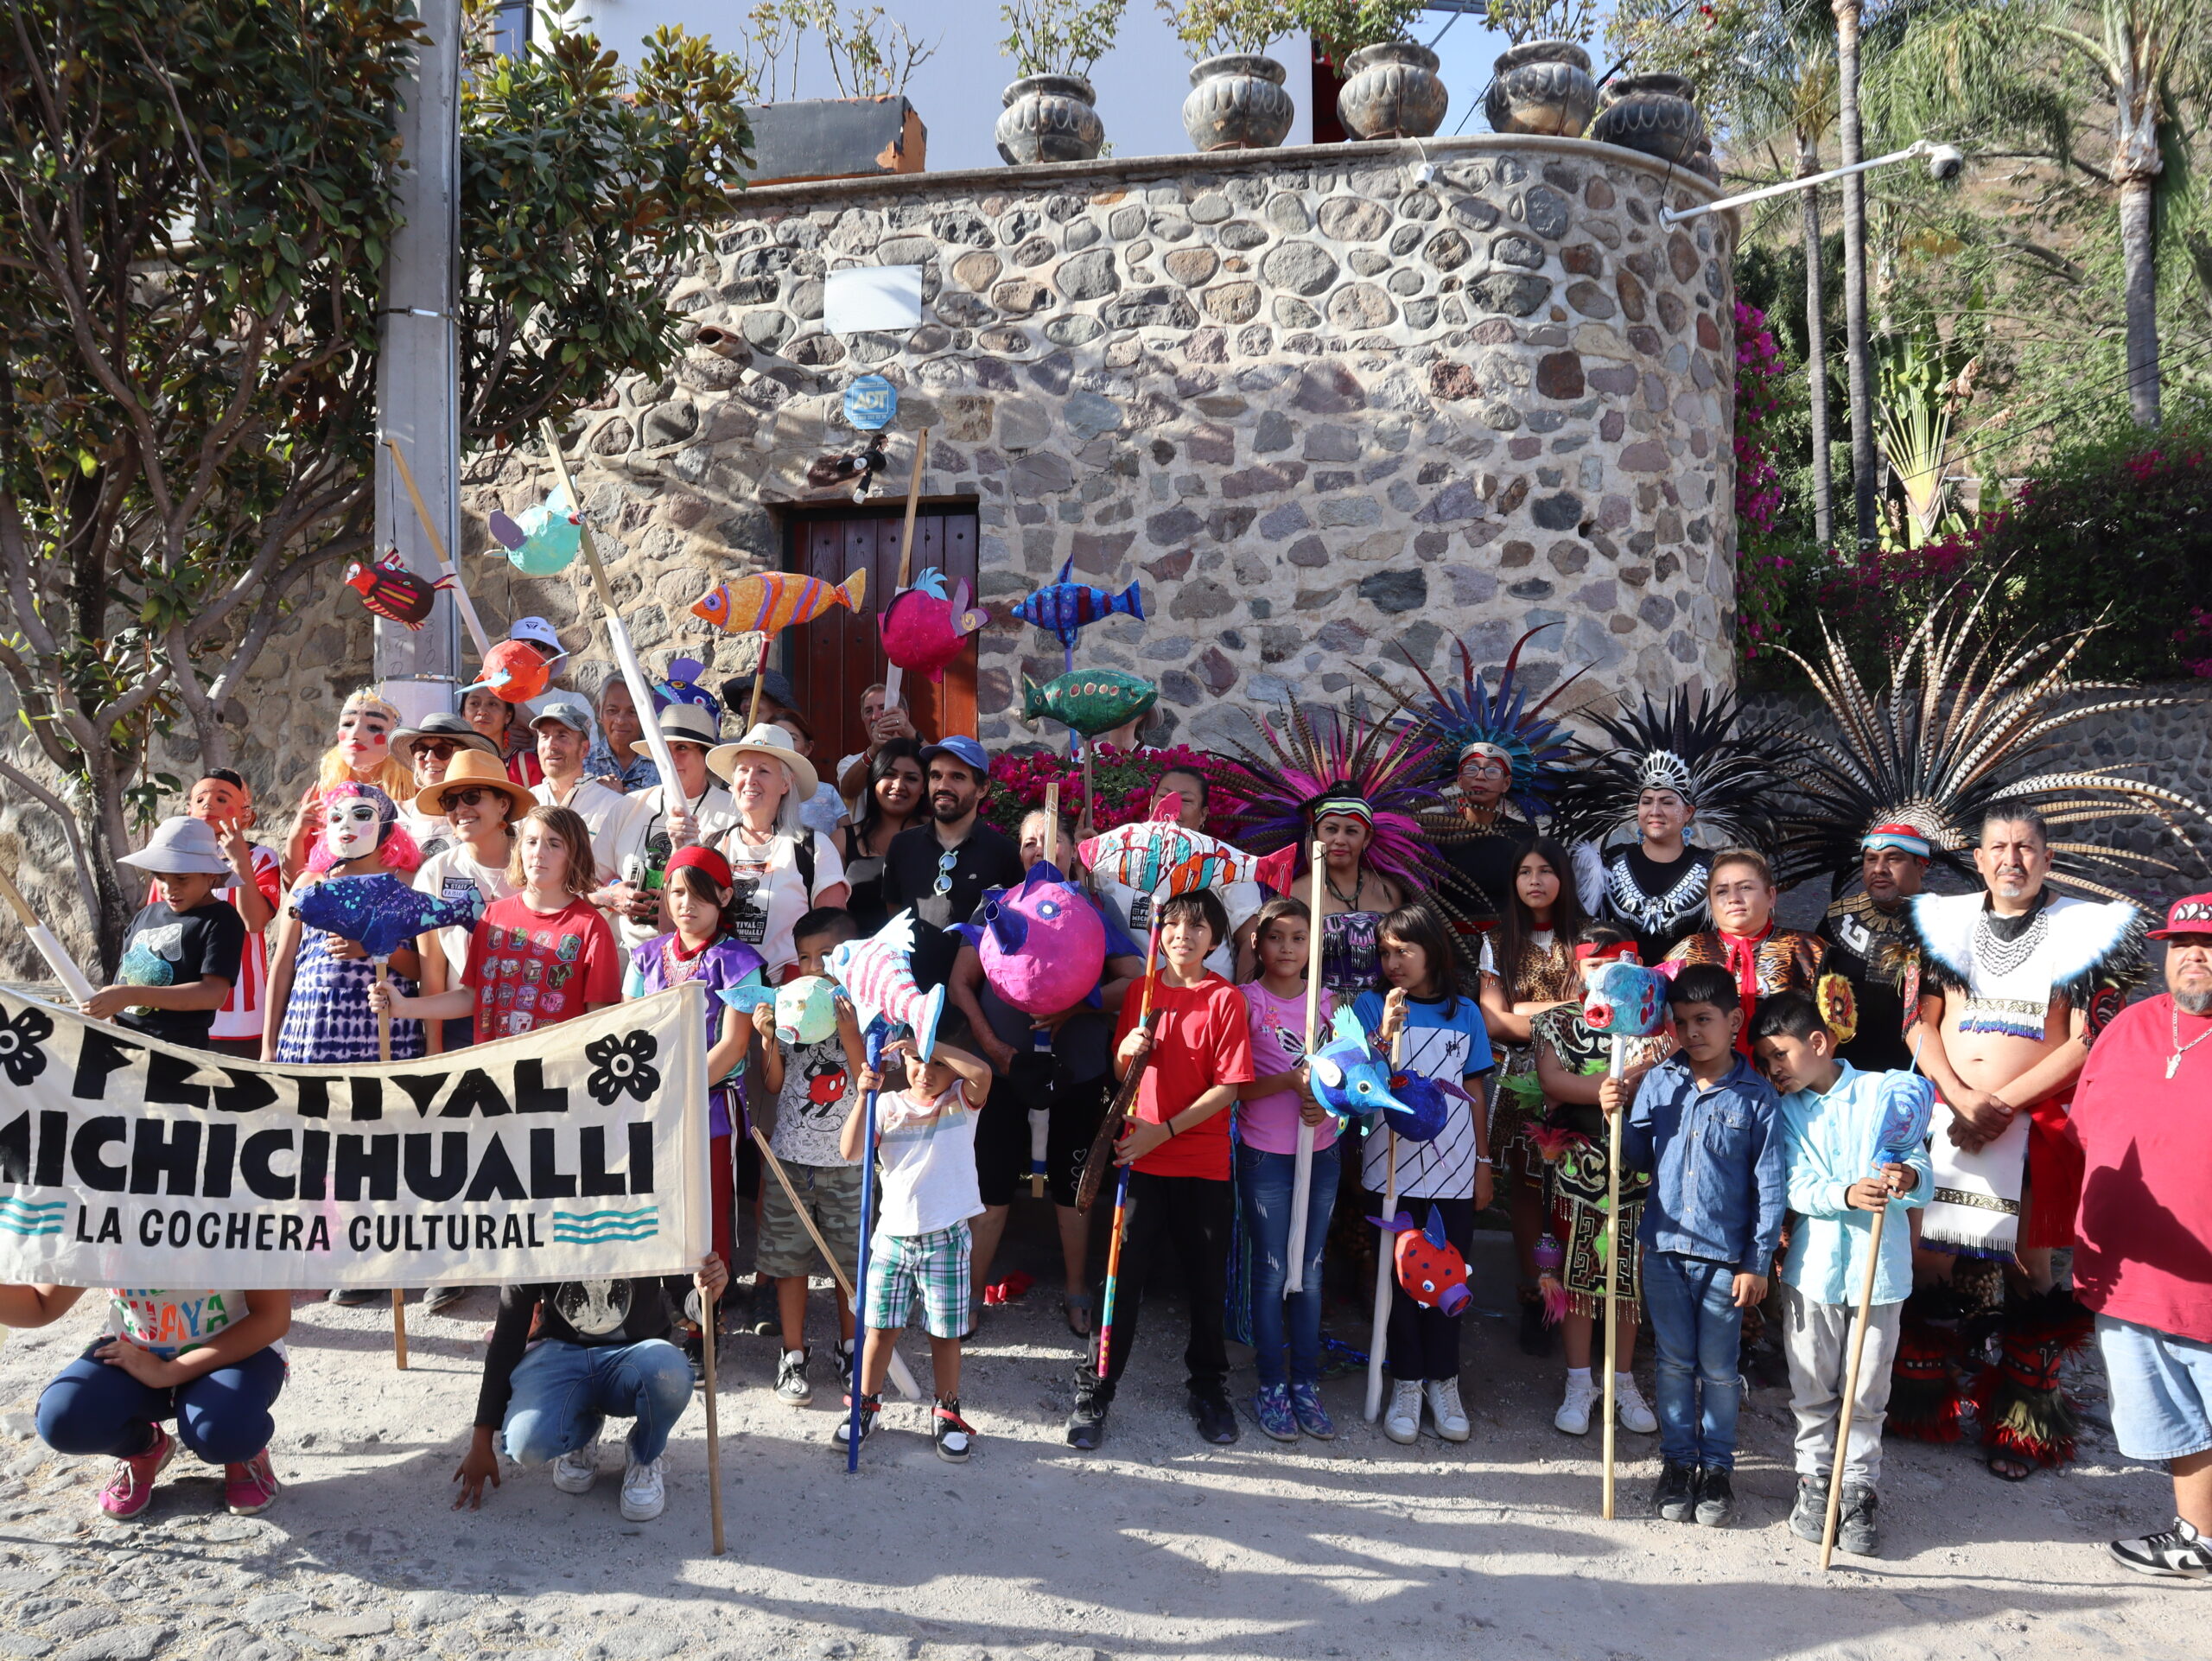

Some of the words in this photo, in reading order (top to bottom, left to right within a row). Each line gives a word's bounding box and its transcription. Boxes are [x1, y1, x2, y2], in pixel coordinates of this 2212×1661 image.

[853, 391, 888, 410] ADT
[73, 1025, 569, 1122] FESTIVAL
[76, 1205, 123, 1244] LA
[139, 1208, 331, 1251] COCHERA
[348, 1212, 544, 1253] CULTURAL
